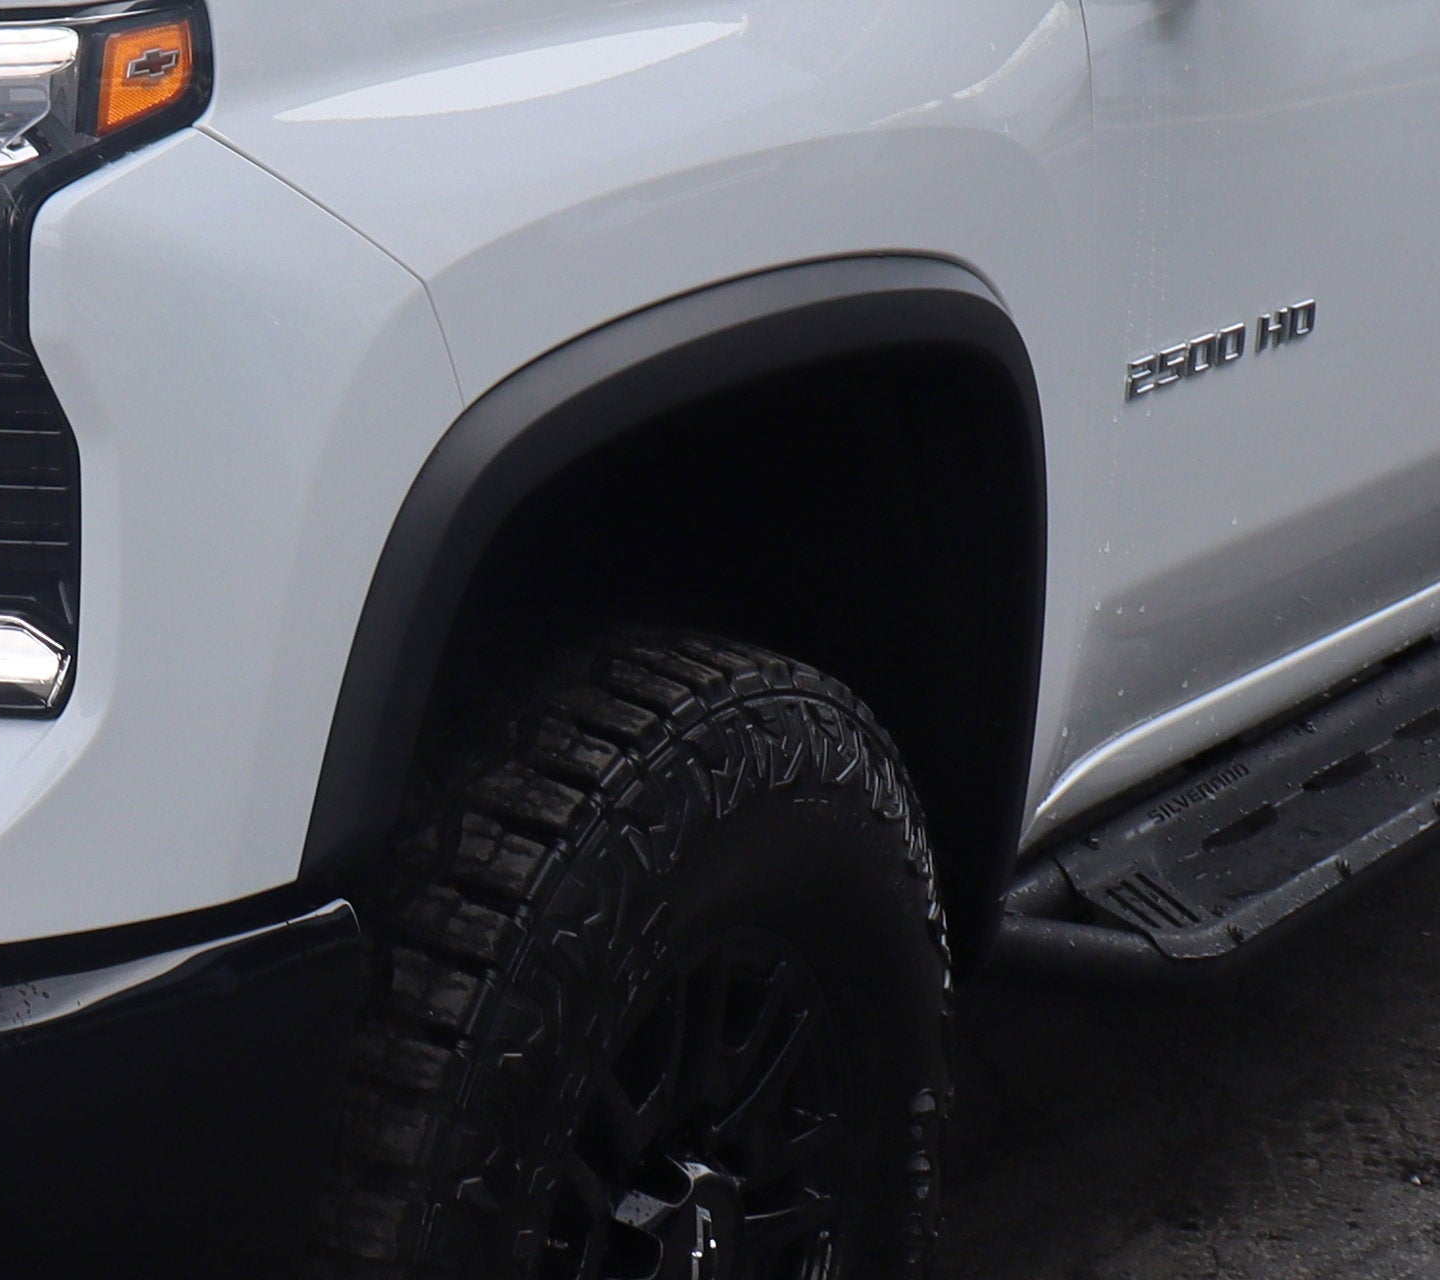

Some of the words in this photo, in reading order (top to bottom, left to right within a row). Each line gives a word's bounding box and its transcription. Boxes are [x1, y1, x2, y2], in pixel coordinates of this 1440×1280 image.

[1124, 322, 1246, 402] 2500
[1255, 298, 1316, 354] HD
[1147, 762, 1251, 824] SILVERADO
